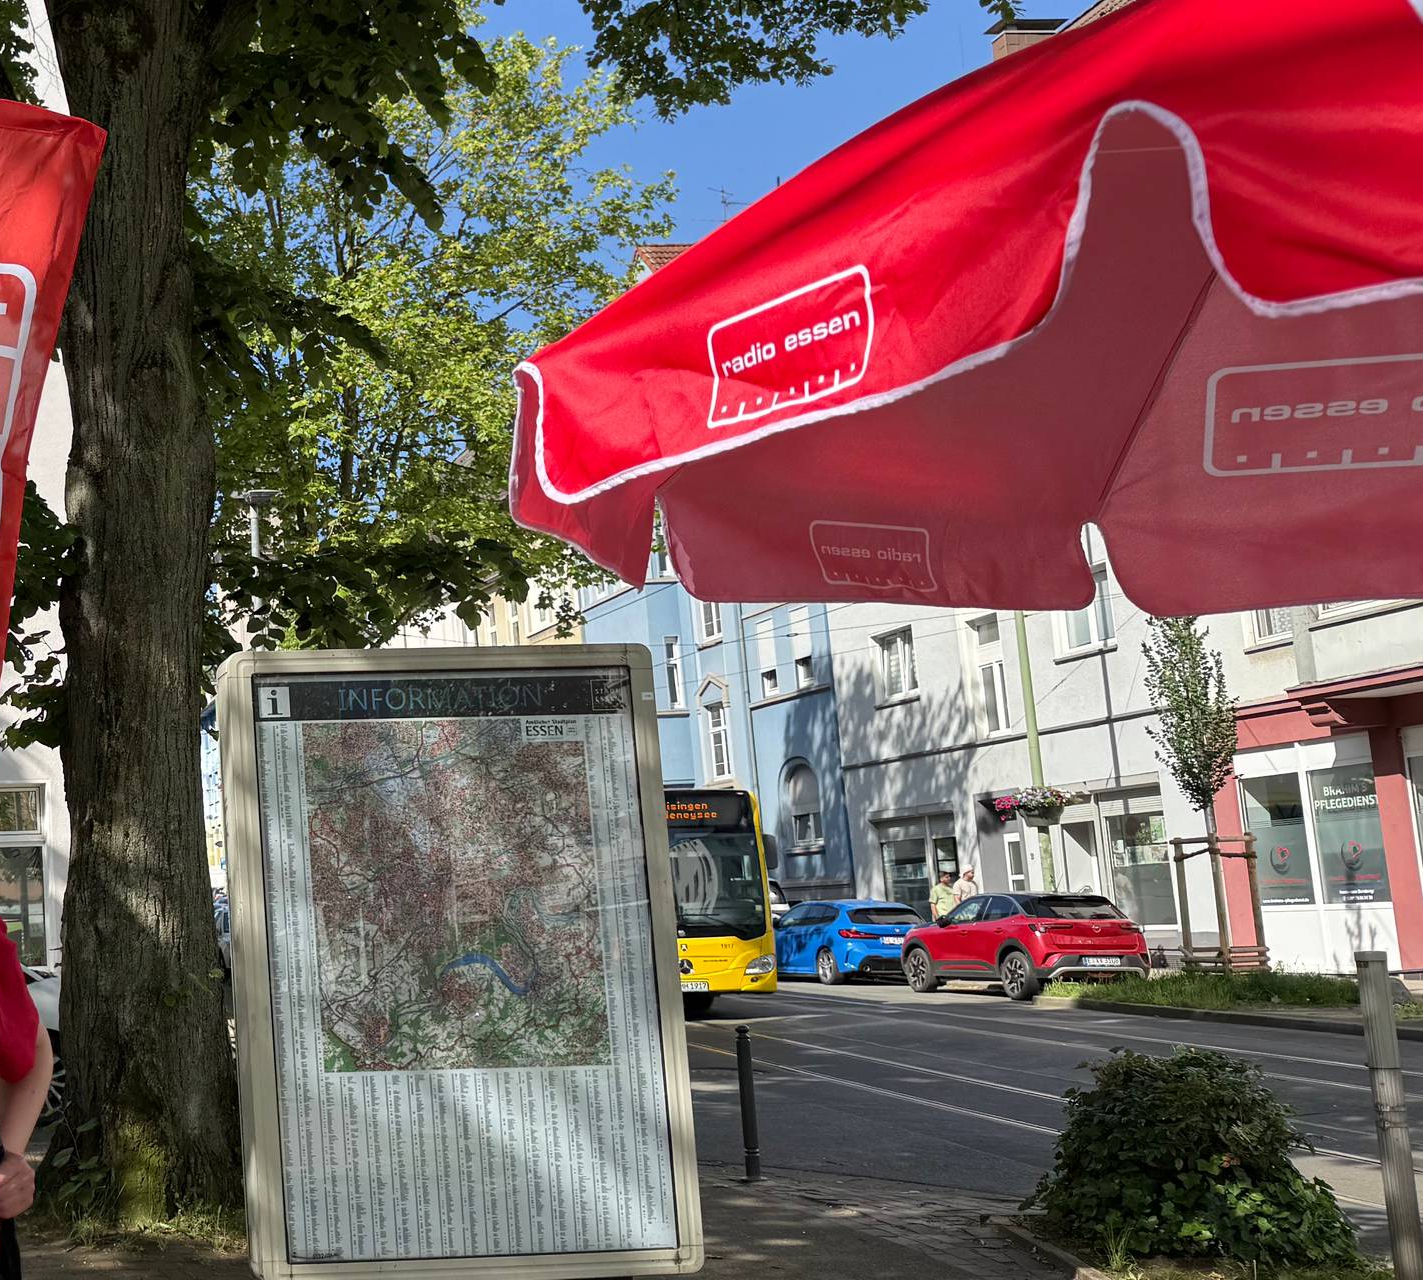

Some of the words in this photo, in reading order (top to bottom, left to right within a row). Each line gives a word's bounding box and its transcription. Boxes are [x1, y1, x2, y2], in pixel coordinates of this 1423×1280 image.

[721, 342, 776, 377] radio
[784, 310, 861, 352] essen
[338, 683, 542, 711] INFORMATION
[526, 725, 564, 736] ESSEN
[666, 802, 708, 811] isingen
[1314, 794, 1379, 811] PFLEGEDIENST
